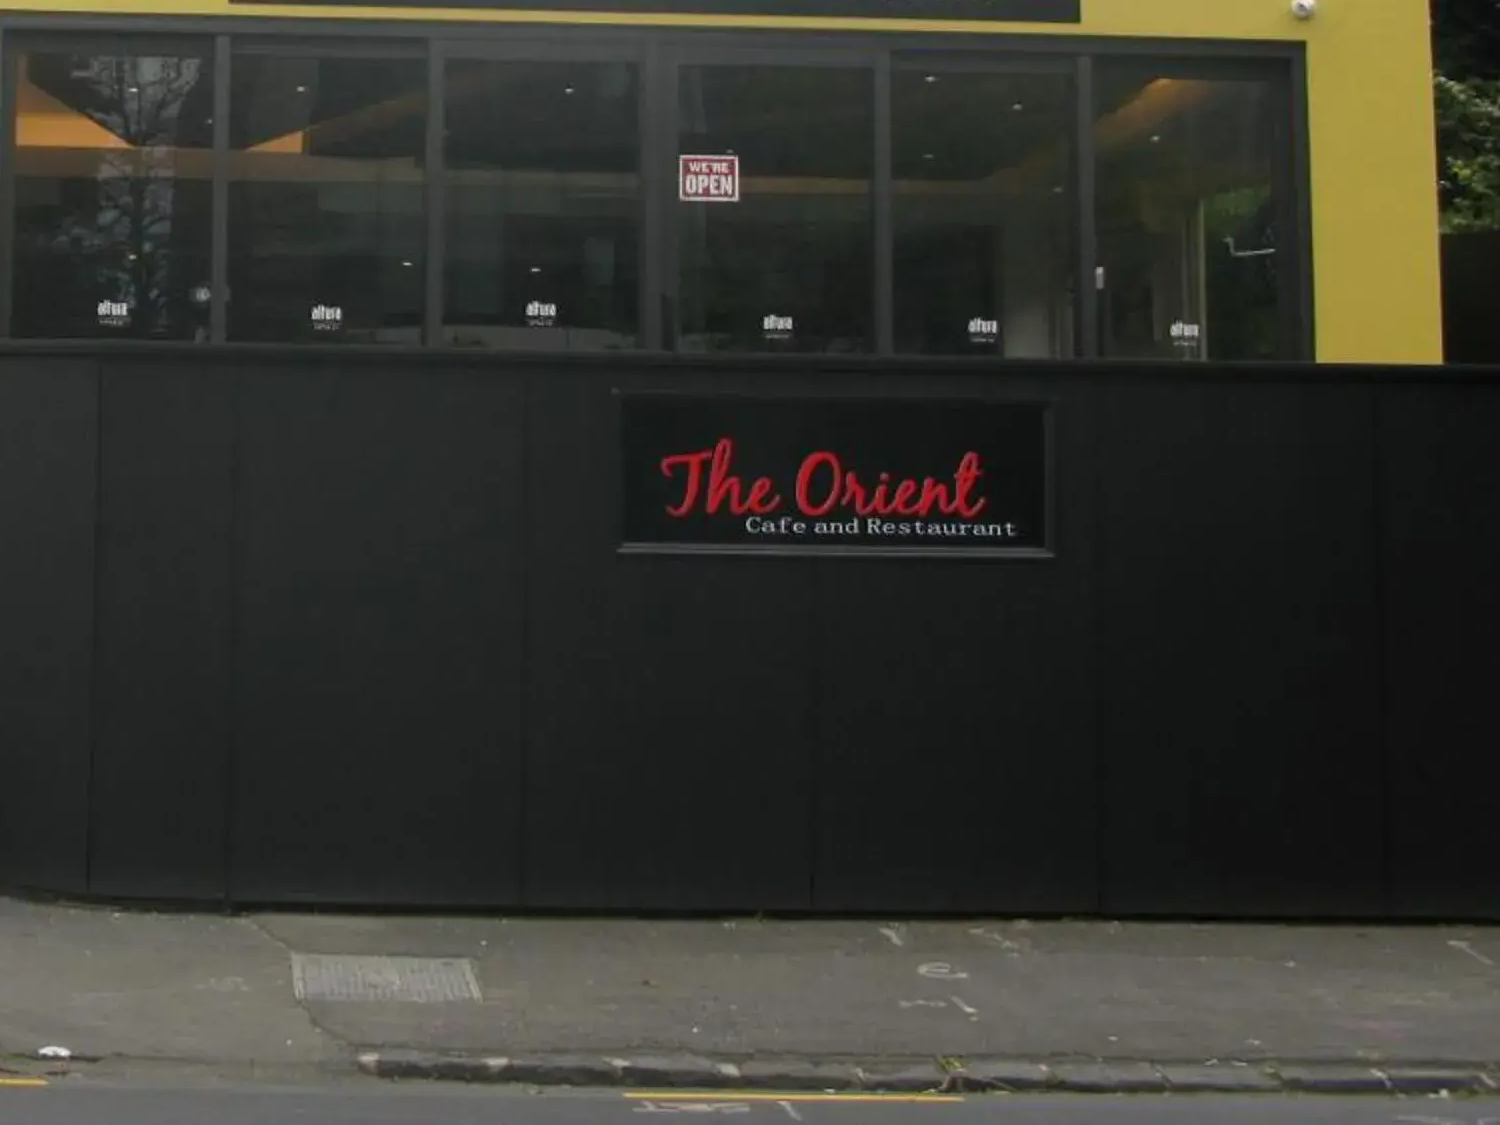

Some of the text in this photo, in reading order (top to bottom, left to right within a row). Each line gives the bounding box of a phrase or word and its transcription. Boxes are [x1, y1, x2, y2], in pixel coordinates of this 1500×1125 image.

[686, 174, 733, 195] OPEN
[661, 438, 986, 519] The Orient
[745, 516, 1016, 537] Cafe and Restaurant
